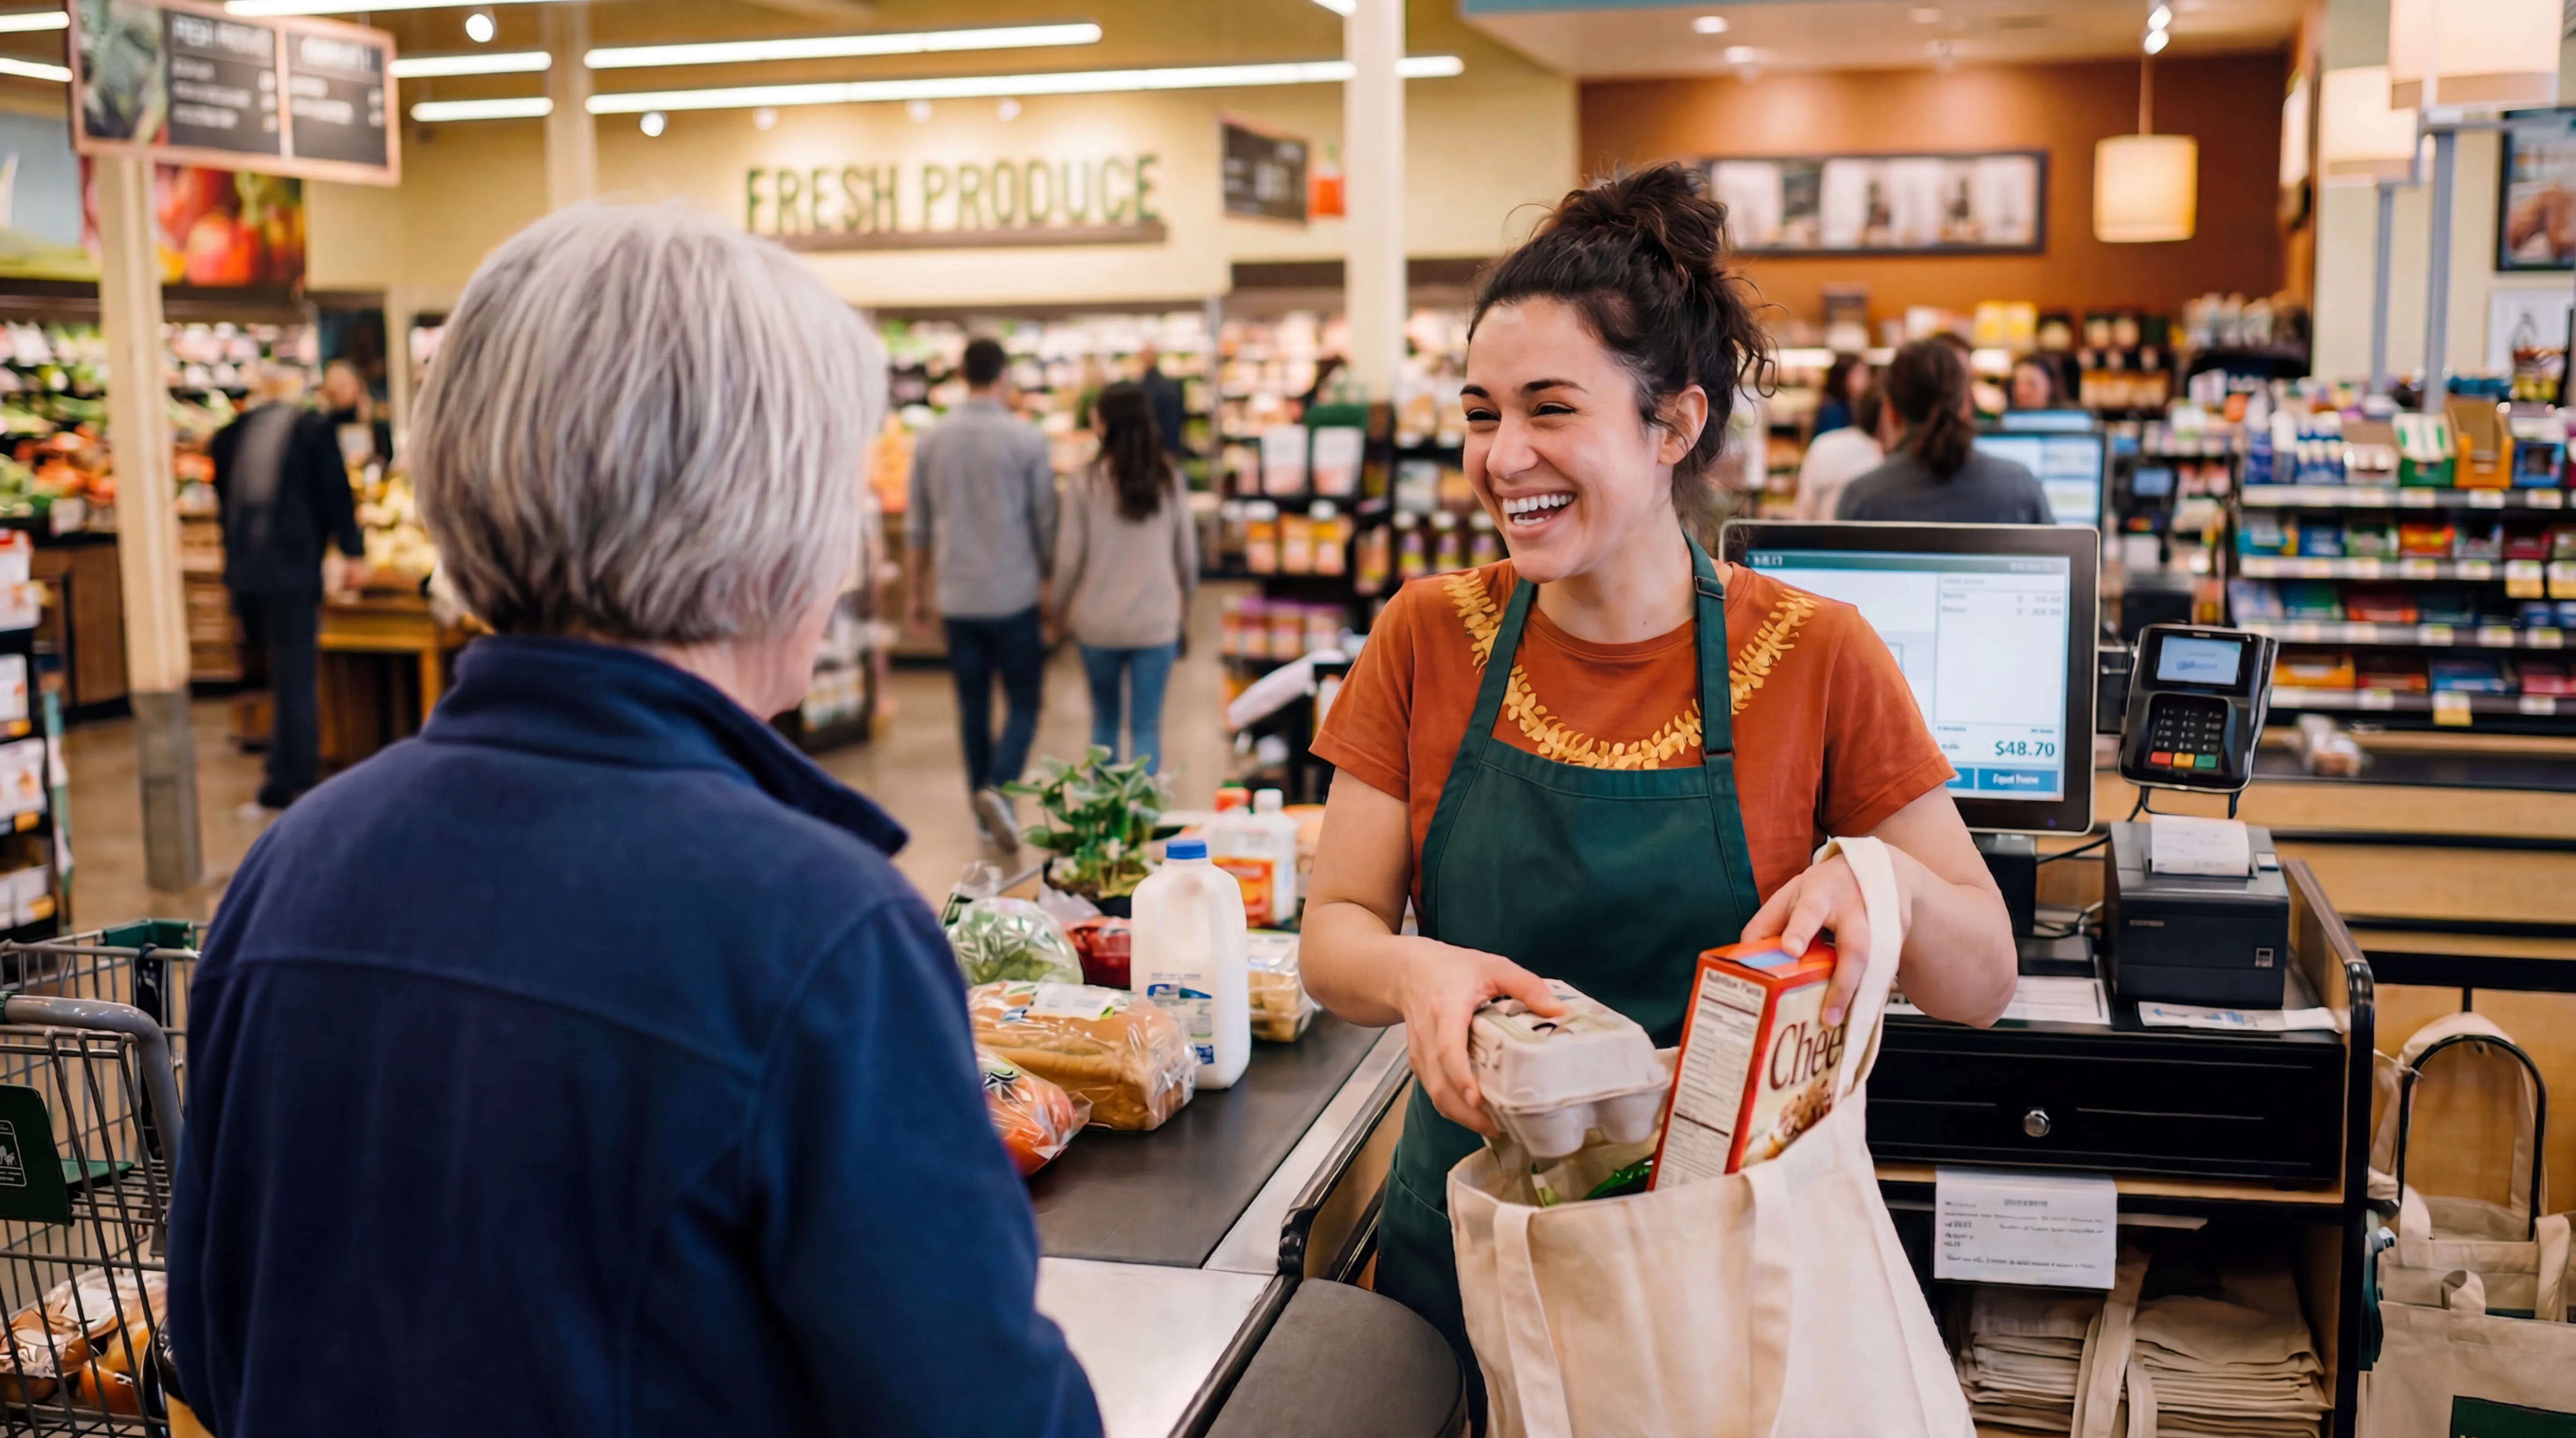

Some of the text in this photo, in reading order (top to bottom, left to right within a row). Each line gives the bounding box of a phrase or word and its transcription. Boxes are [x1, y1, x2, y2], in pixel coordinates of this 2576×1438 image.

[746, 164, 900, 233] FRESH
[922, 154, 1159, 230] PRODUCE
[1995, 740, 2055, 757] $48.70
